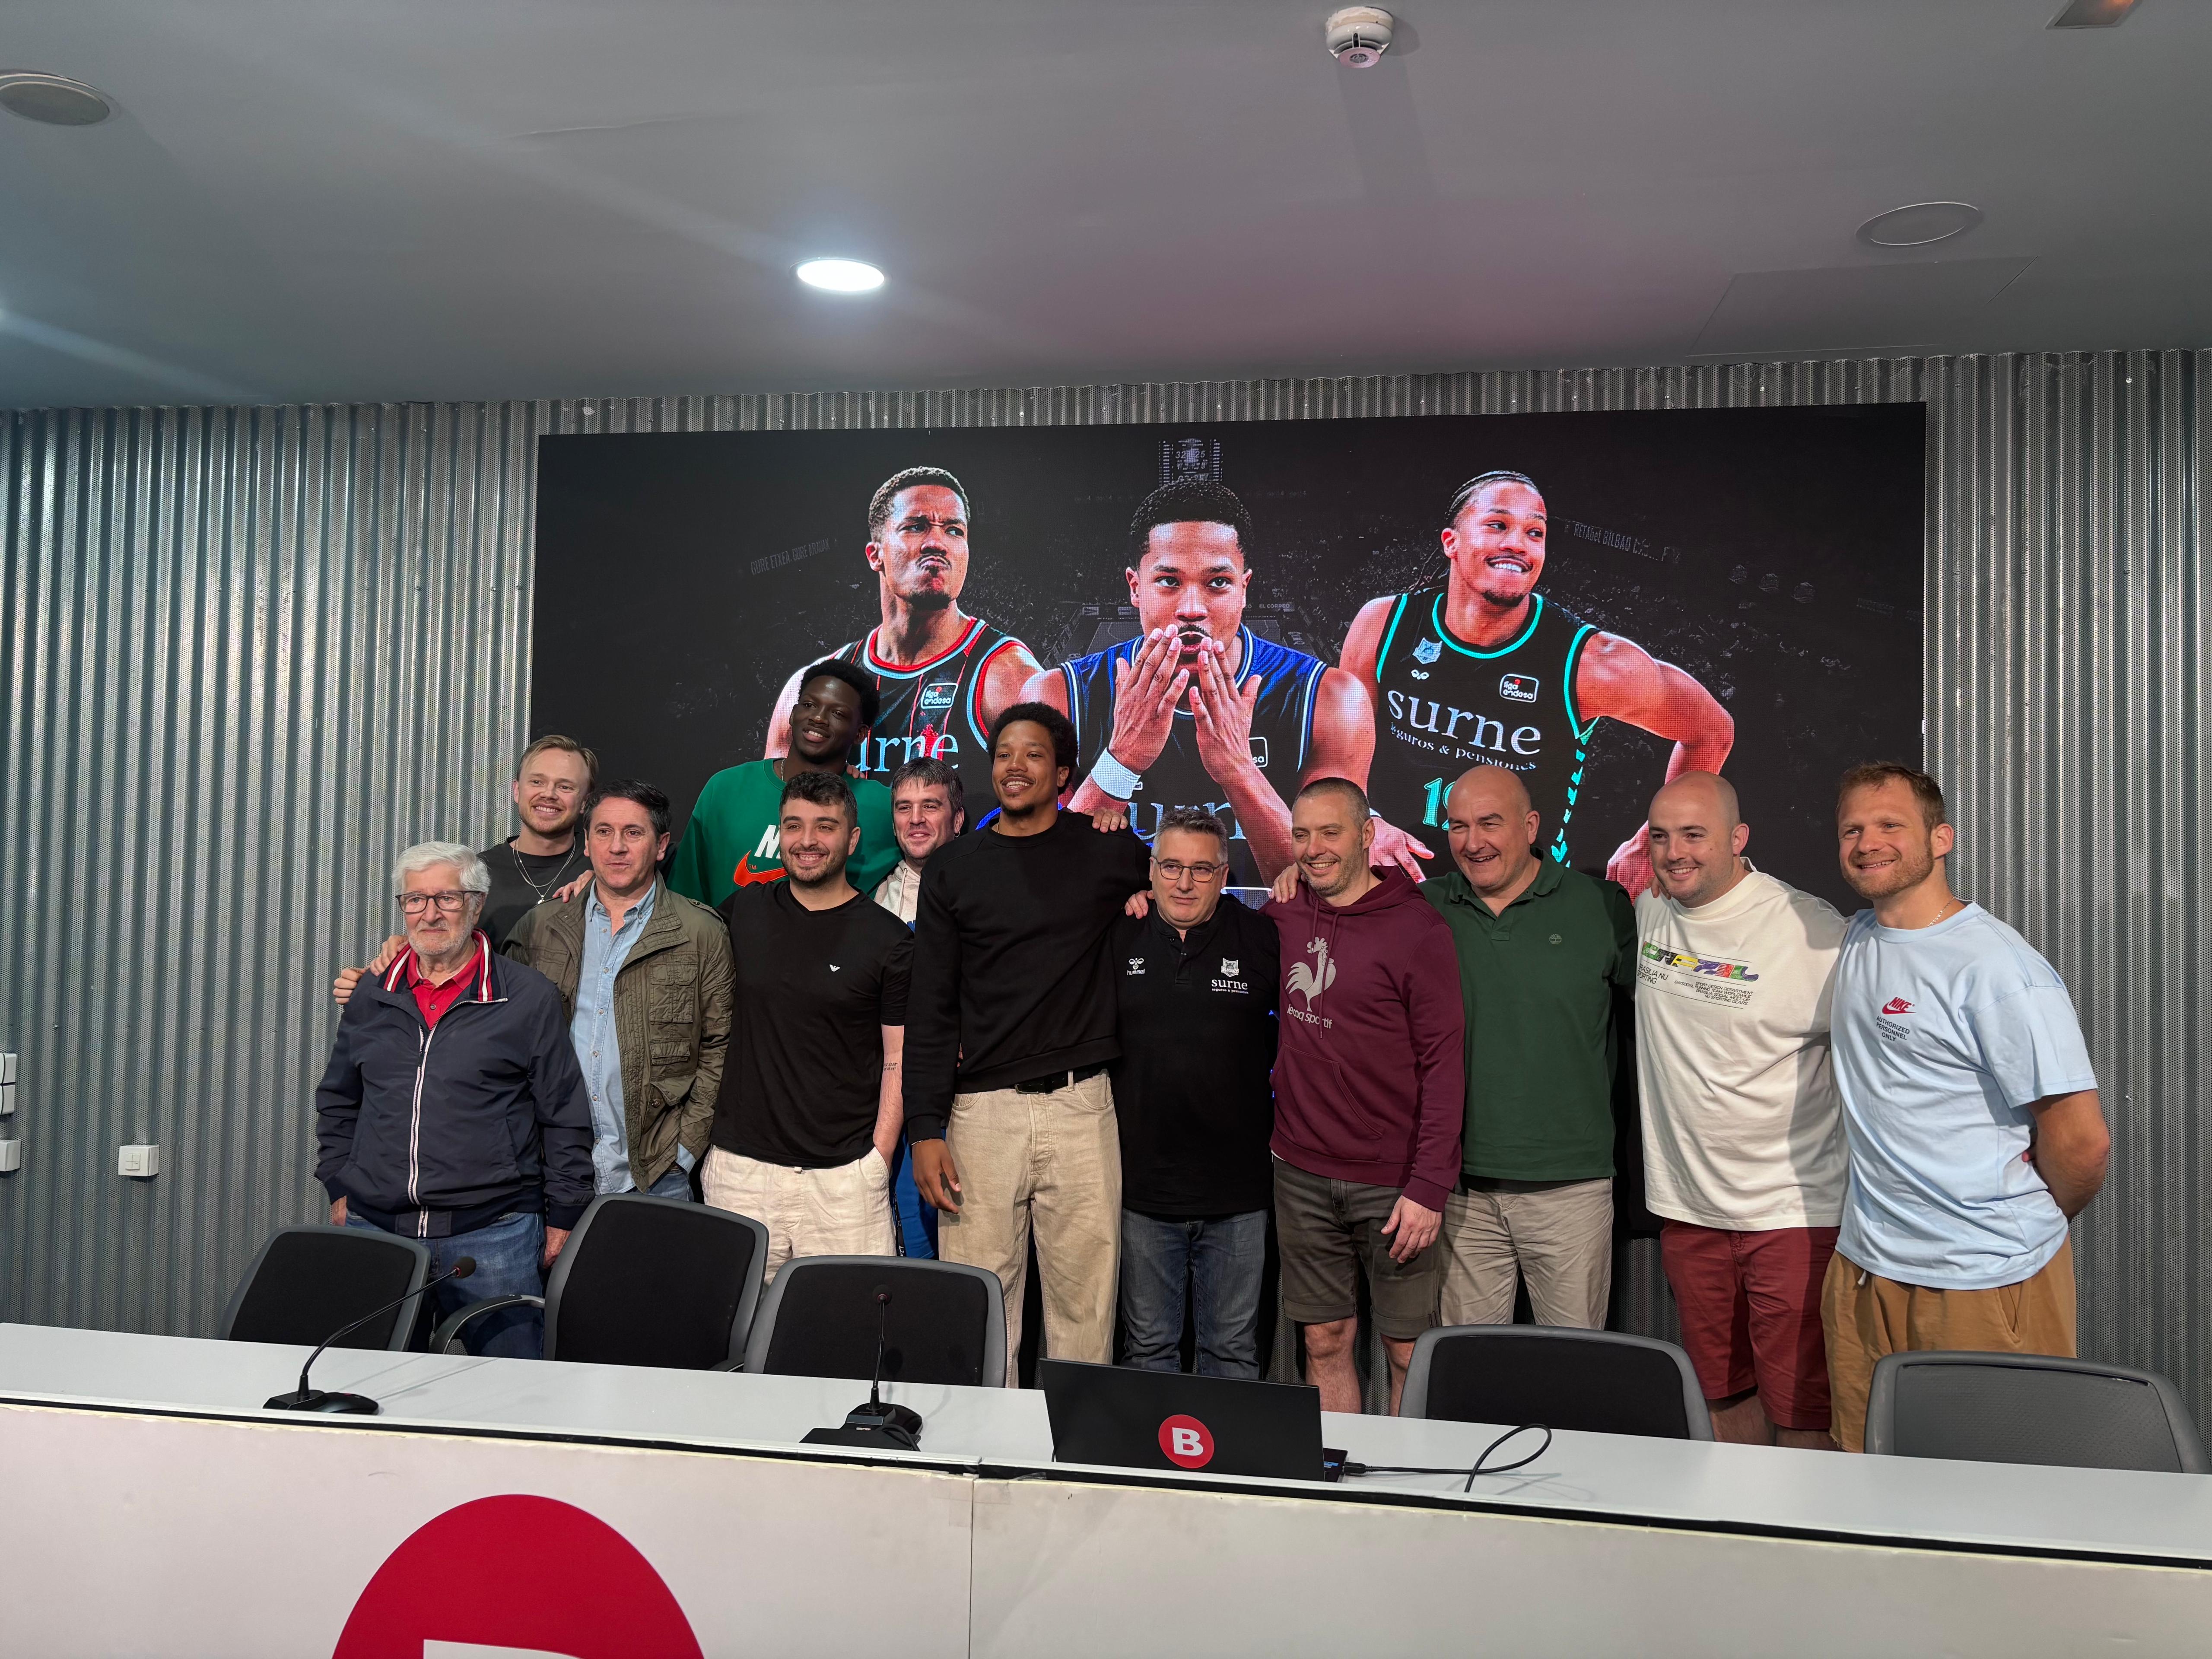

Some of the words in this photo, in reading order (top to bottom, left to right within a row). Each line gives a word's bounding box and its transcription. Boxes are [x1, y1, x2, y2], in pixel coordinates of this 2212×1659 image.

[1603, 531, 1632, 551] BILBAO
[750, 557, 770, 576] GURE
[792, 545, 808, 561] GURE
[1387, 690, 1541, 755] surne
[1439, 745, 1450, 755] &
[1211, 979, 1248, 990] surne
[1888, 997, 1912, 1012] NIKE
[1293, 1008, 1305, 1022] coq
[1876, 1016, 1910, 1034] AUTHORIZED
[1876, 1022, 1907, 1040] PERSONNEL
[1881, 1032, 1896, 1042] ONLY
[1172, 1427, 1204, 1456] B
